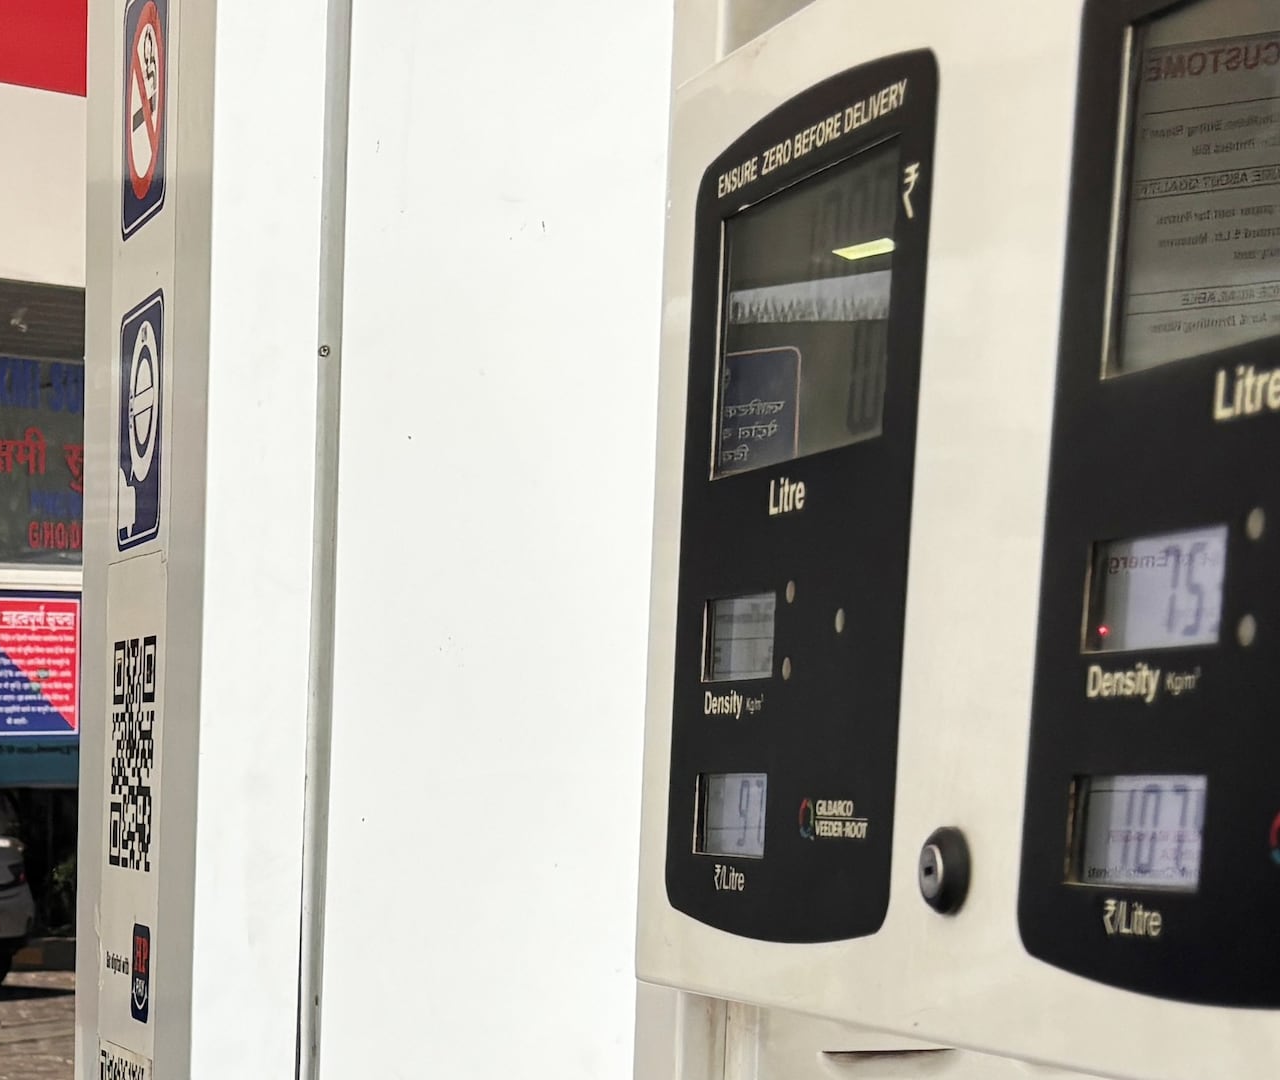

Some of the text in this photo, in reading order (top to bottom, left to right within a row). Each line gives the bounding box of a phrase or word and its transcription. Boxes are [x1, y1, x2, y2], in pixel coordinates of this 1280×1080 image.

[717, 78, 909, 199] ENSURE ZERO BEFORE DELIVERY
[902, 161, 919, 219] ₹
[769, 478, 805, 515] Litre
[1086, 664, 1160, 702] Density
[703, 690, 743, 720] Density
[815, 799, 854, 818] GILBARCO
[815, 819, 868, 839] VEEDER-ROOT
[713, 863, 745, 892] ₹/Litre
[1103, 898, 1162, 937] ₹/Litre
